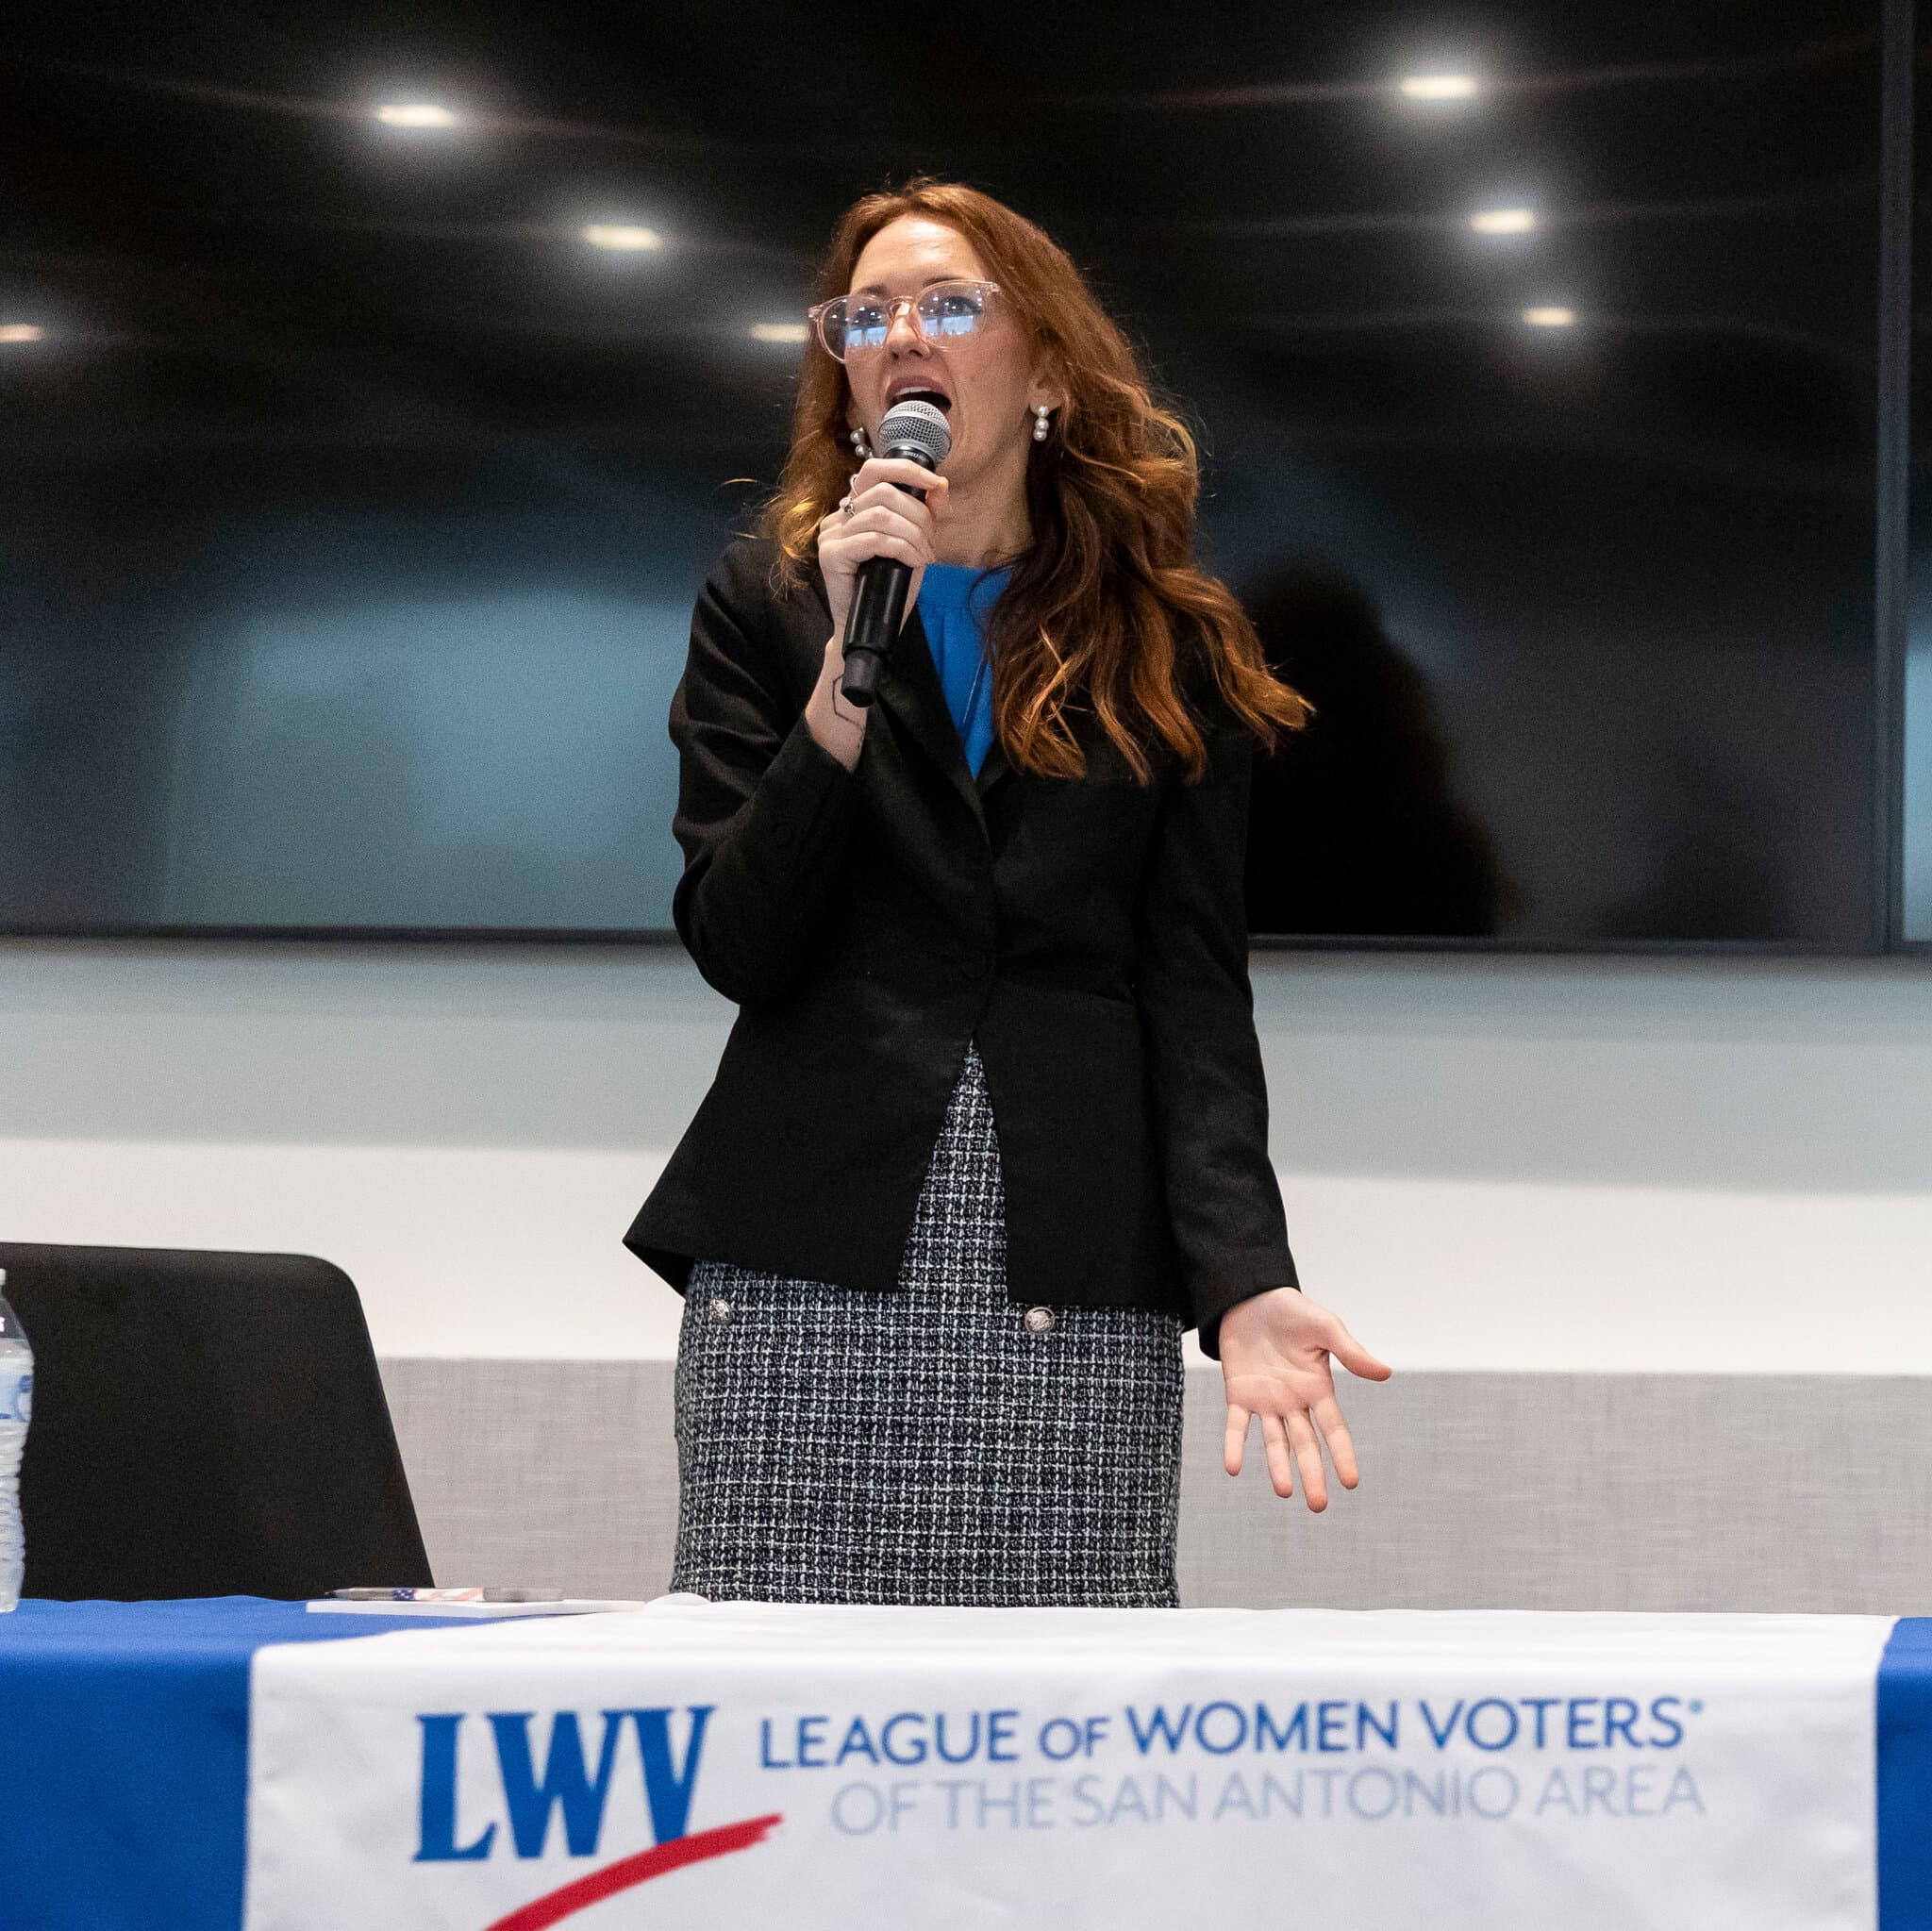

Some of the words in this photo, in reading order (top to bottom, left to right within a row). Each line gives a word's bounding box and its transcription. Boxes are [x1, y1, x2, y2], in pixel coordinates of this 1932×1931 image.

[759, 1709, 1020, 1770] LEAGUE
[1039, 1717, 1109, 1762] OF
[1126, 1701, 1399, 1756] WOMEN
[412, 1705, 716, 1863] LWV
[830, 1780, 920, 1837] OF
[934, 1777, 1055, 1831] THE
[1071, 1773, 1199, 1826] SAN
[1213, 1765, 1520, 1822] ANTONIO
[1536, 1763, 1706, 1818] AREA
